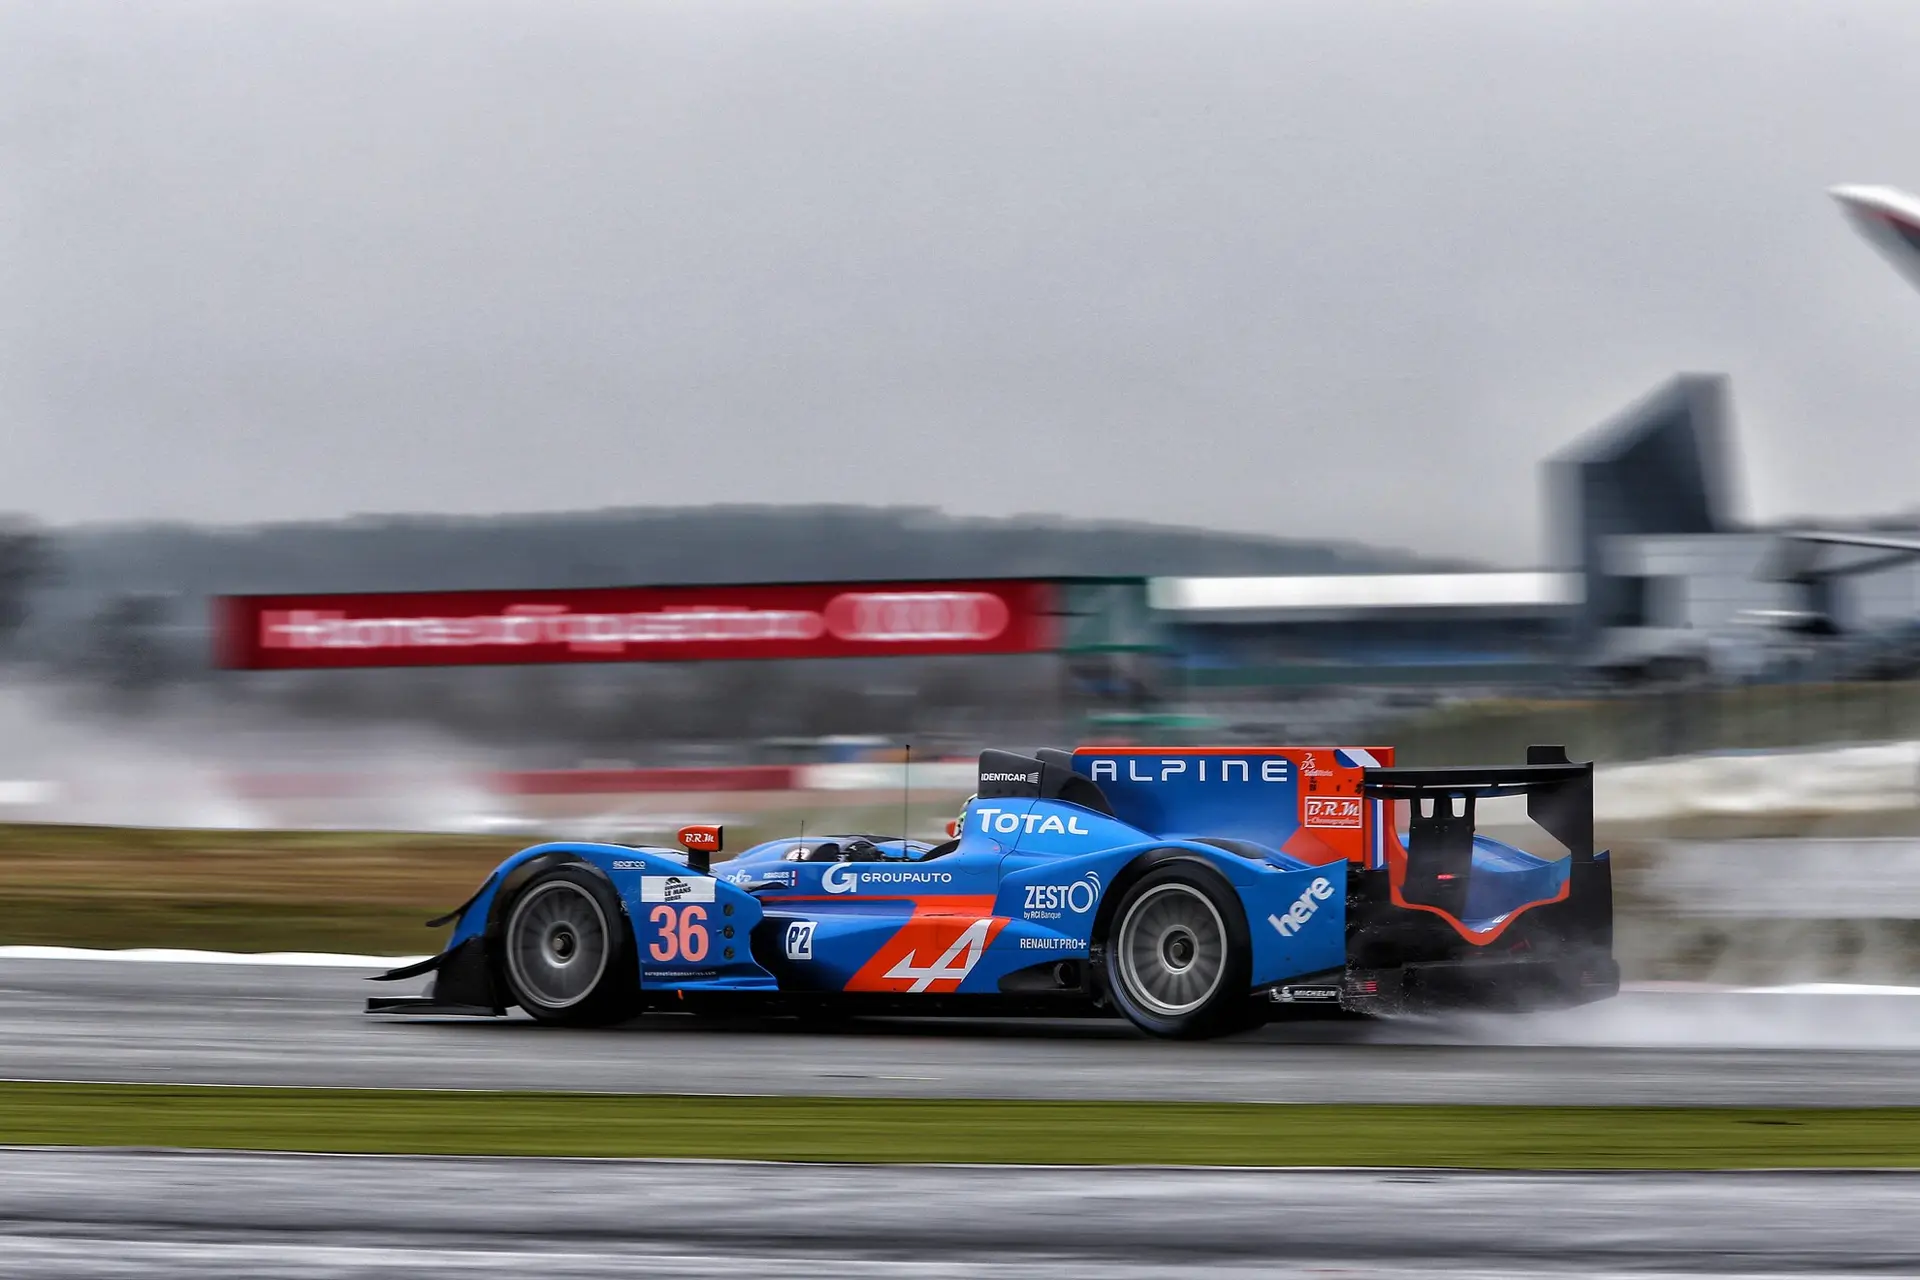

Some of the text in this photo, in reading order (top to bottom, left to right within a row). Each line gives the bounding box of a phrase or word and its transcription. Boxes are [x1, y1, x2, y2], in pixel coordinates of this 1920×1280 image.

[1091, 760, 1288, 782] ALPINE
[981, 773, 1026, 782] IDENTICAR
[612, 860, 646, 870] sparco
[861, 873, 952, 883] GROUPAUTO
[673, 886, 692, 896] MANS
[1266, 875, 1336, 938] here
[649, 905, 709, 962] 36
[788, 927, 811, 954] P2
[1020, 938, 1087, 950] RENAULT PRO+
